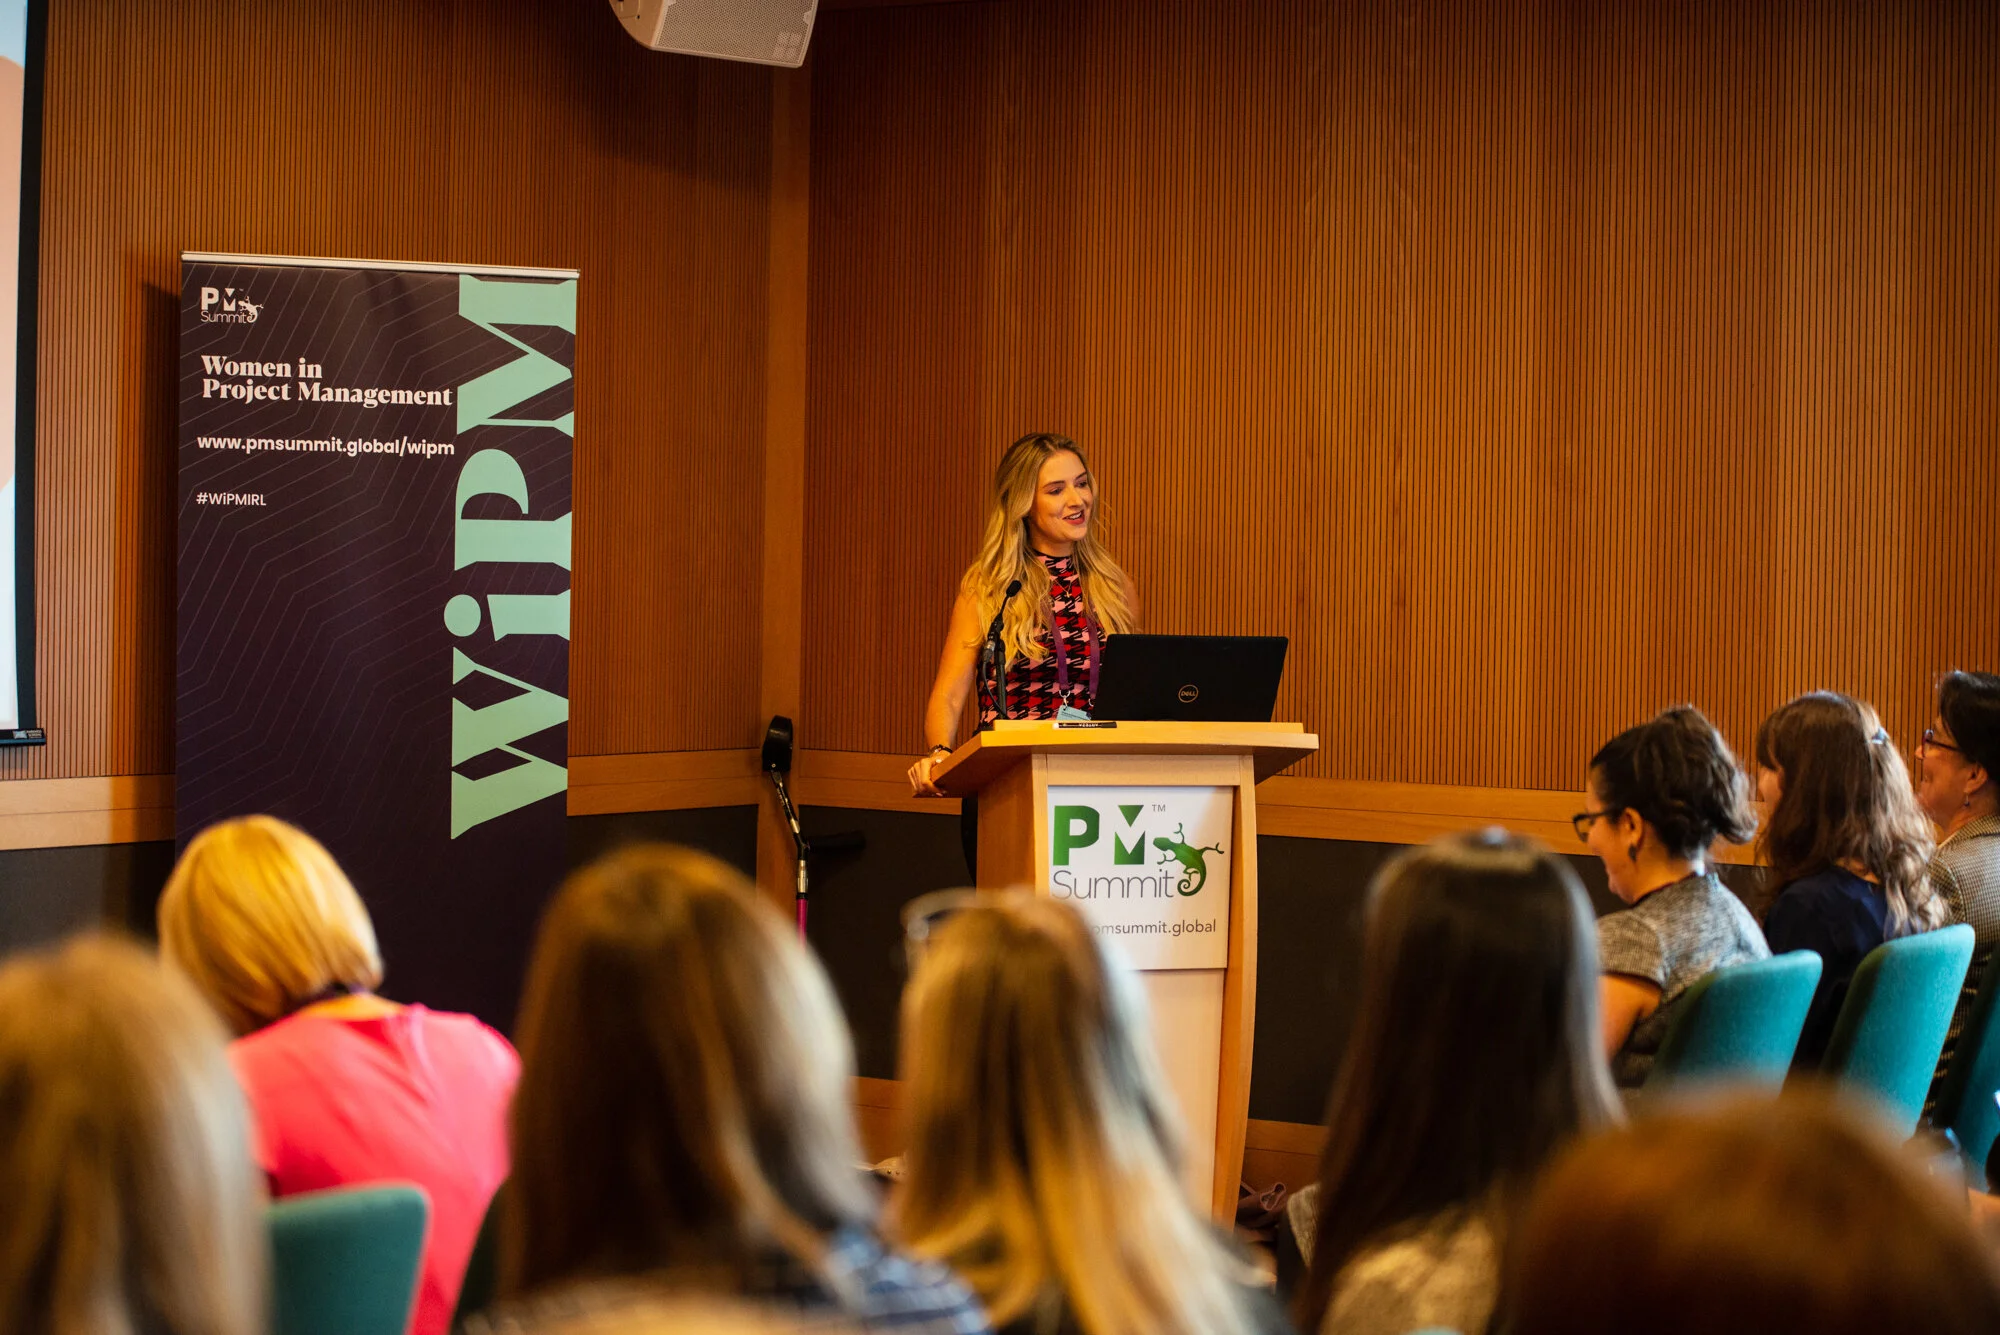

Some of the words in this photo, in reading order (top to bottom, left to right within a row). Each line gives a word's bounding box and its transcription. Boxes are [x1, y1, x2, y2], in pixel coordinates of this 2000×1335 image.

[201, 286, 236, 311] PM
[200, 310, 247, 323] Summit
[201, 355, 292, 378] Women
[298, 357, 323, 379] in
[202, 378, 291, 404] Project
[298, 382, 453, 408] Management
[197, 436, 455, 459] www.pmsummit.global/wipm
[196, 492, 267, 507] #WiPMIRL
[443, 273, 578, 840] WiPM
[1052, 804, 1146, 866] PM
[1151, 804, 1166, 812] TM
[1052, 868, 1174, 900] Summit
